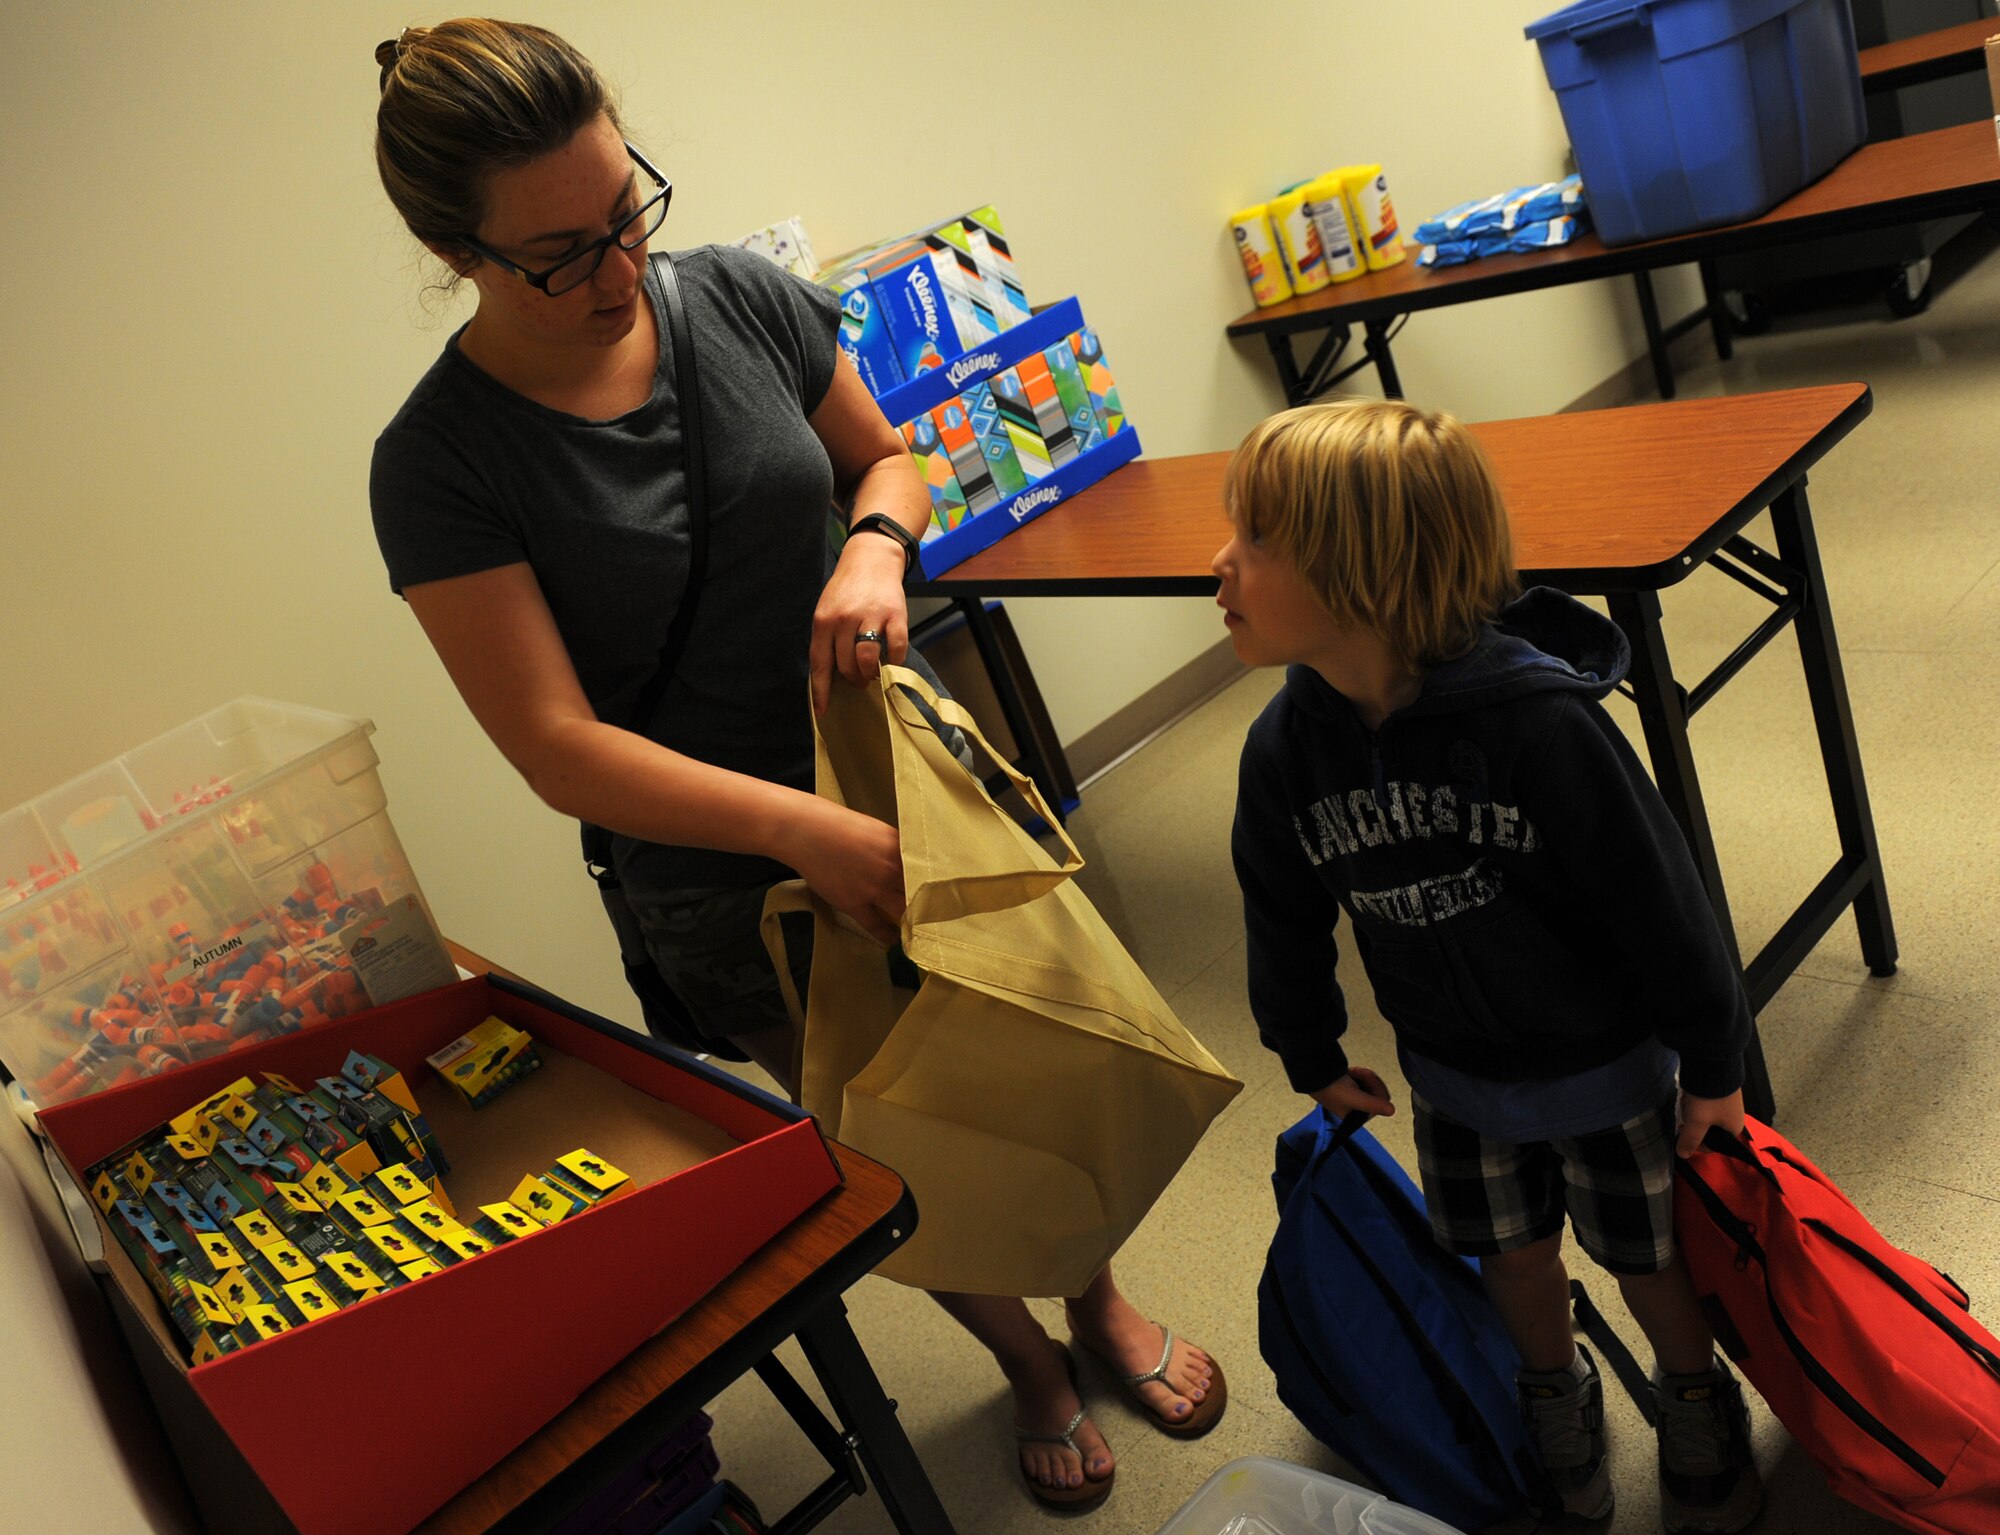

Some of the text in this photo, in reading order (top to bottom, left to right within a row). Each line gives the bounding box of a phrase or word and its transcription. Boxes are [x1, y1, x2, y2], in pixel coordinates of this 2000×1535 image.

[907, 264, 939, 338] Kleenex
[946, 352, 999, 389] Kleenex
[1008, 485, 1060, 522] Kleenex
[193, 937, 242, 969] AUTUMN
